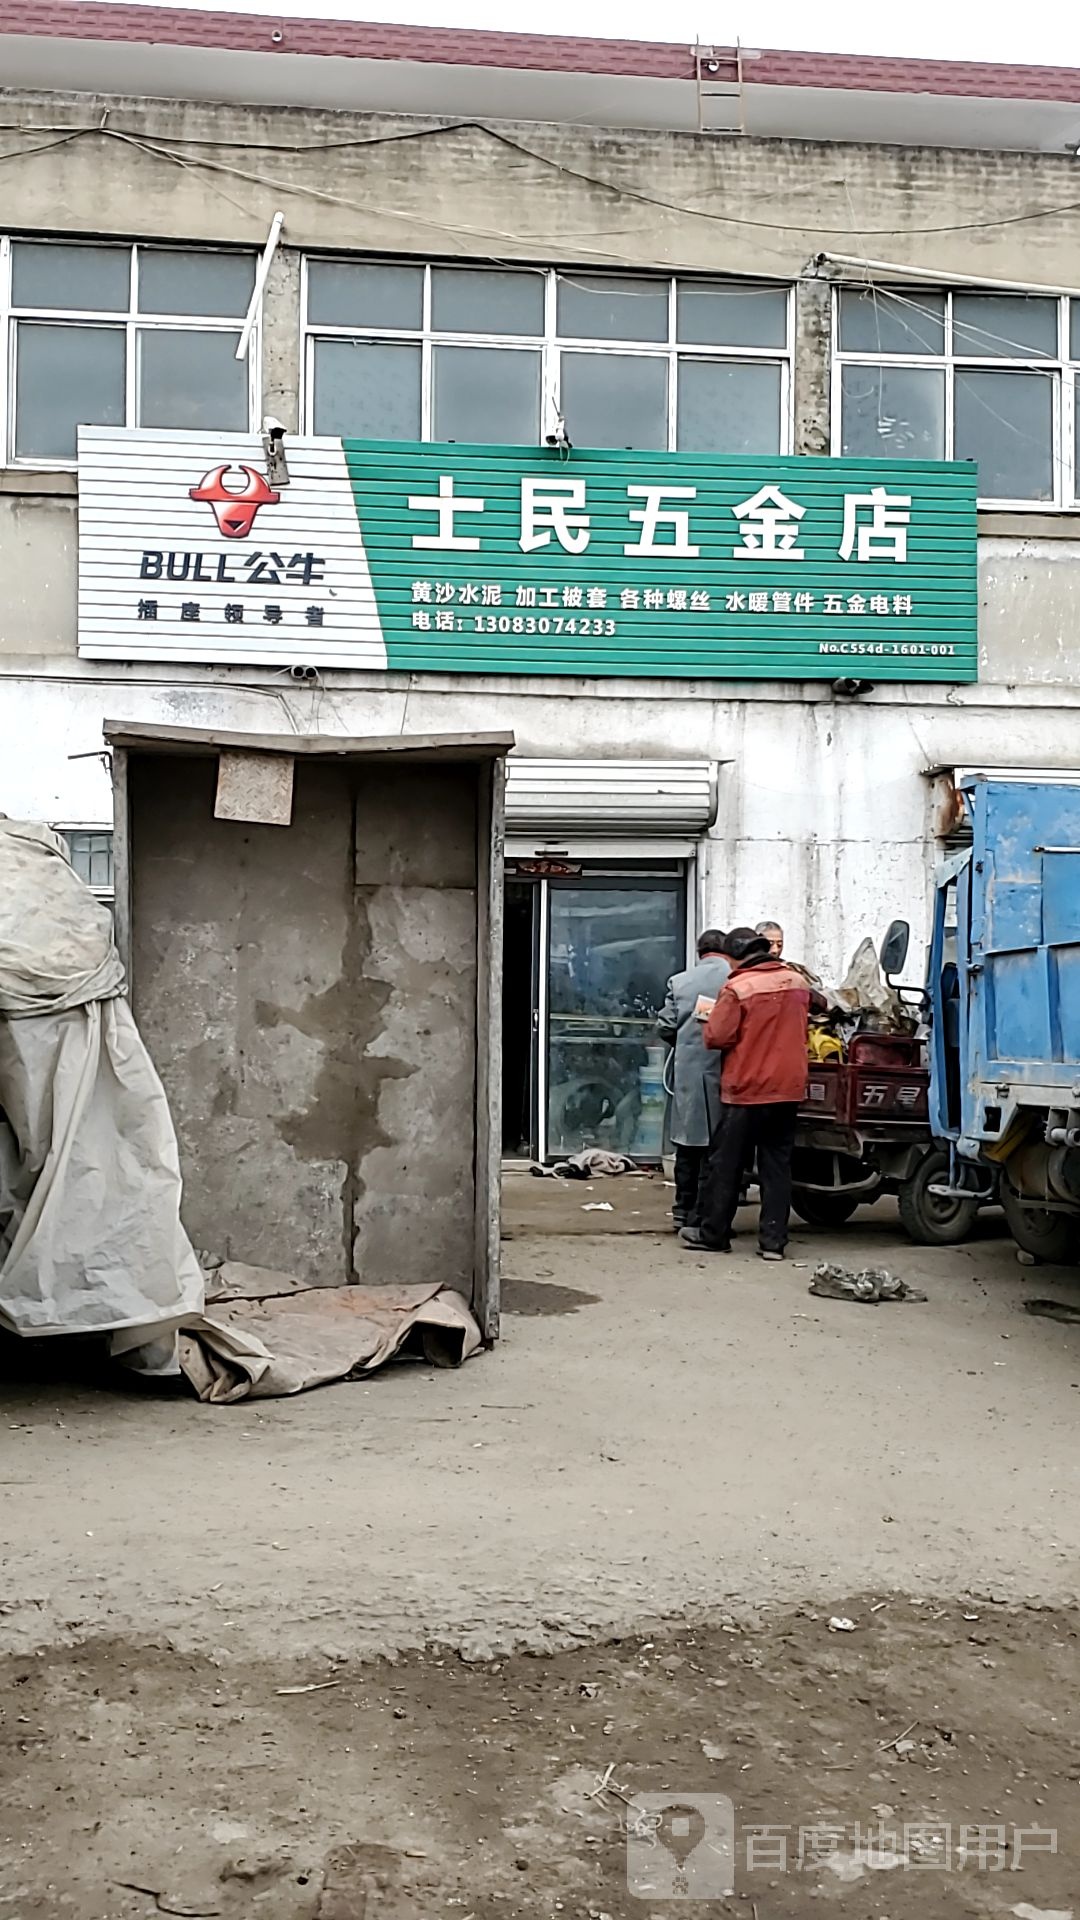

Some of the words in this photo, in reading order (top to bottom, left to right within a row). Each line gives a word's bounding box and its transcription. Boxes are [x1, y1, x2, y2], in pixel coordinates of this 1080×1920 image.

[408, 475, 912, 563] 土民五金店
[411, 581, 502, 604] 黄沙水泥
[515, 585, 607, 608] 加工被套
[620, 588, 711, 611] 各种螺丝
[725, 591, 815, 614] 水暖管件
[822, 594, 914, 616] 五金电料
